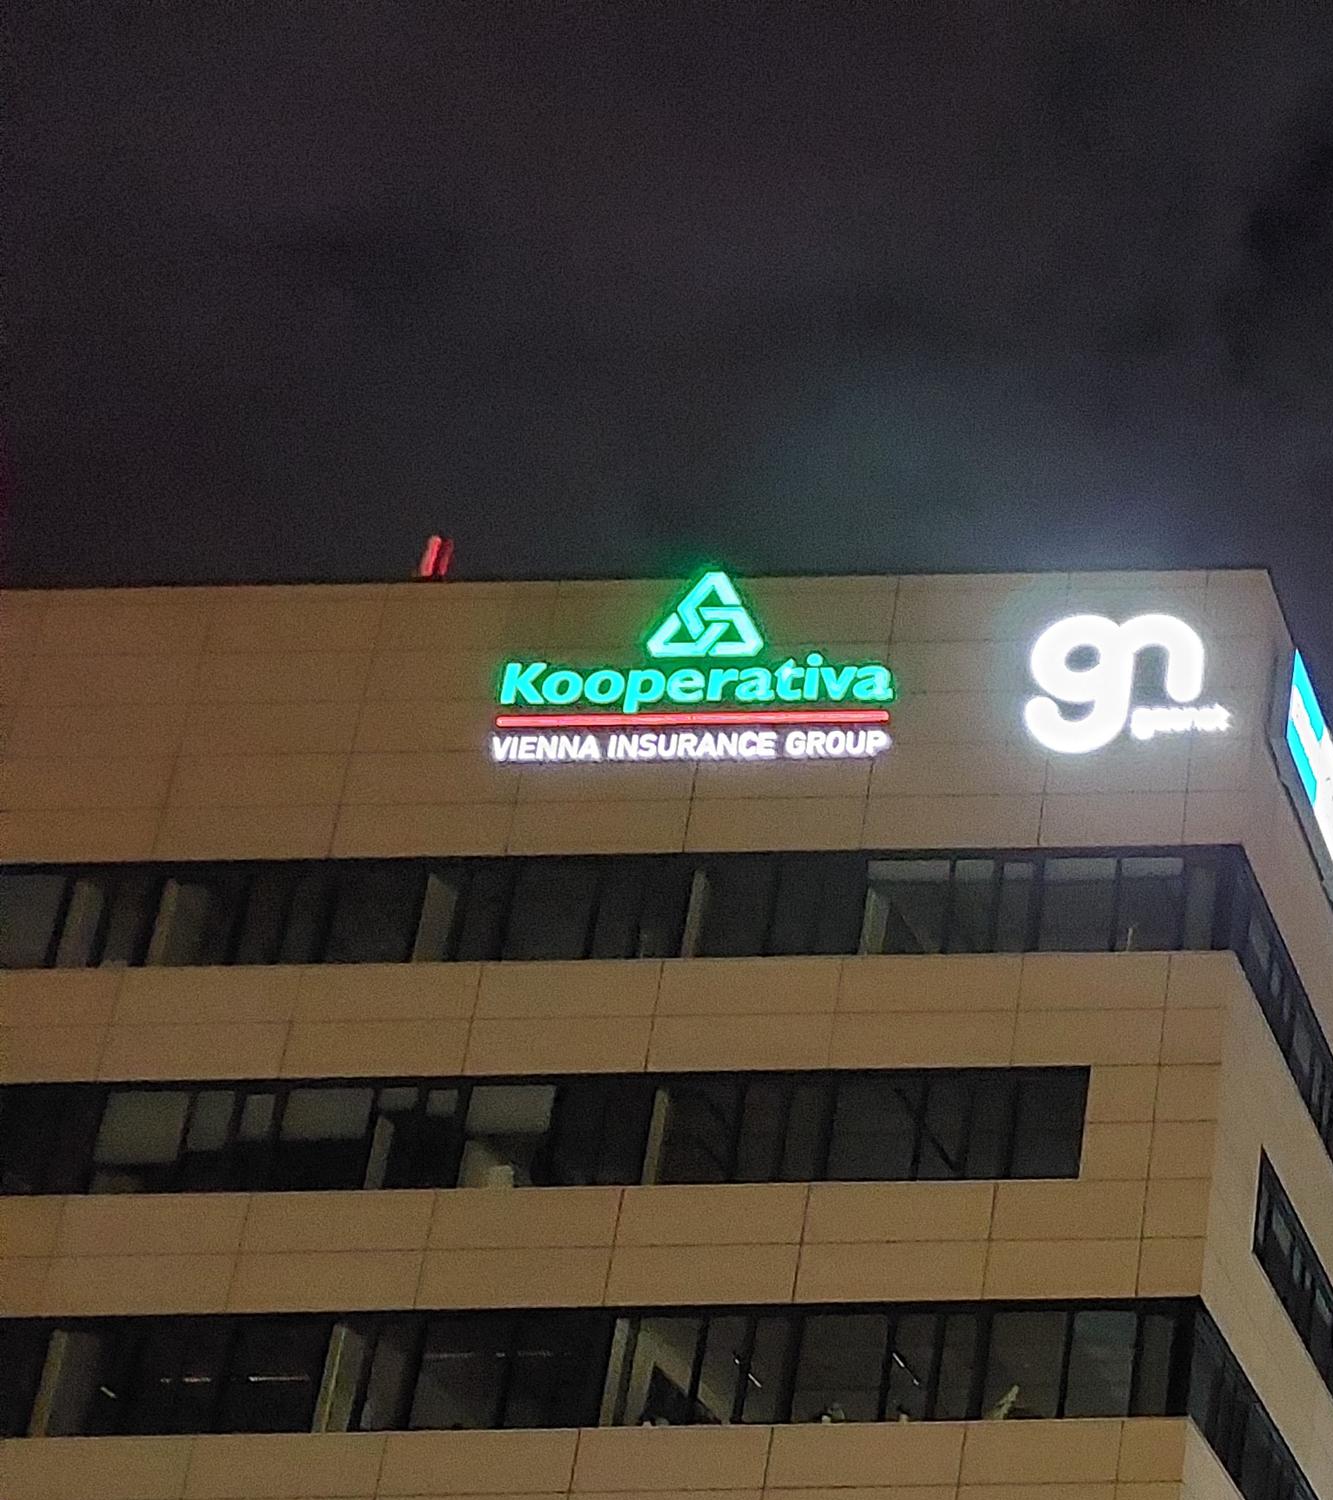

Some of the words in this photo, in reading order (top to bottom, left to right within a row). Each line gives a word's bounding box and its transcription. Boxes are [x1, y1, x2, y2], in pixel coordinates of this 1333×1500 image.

[500, 653, 894, 713] Kooperativa
[491, 735, 600, 762] VIENNA
[607, 731, 777, 760] INSURANCE
[785, 730, 892, 756] GROUP
